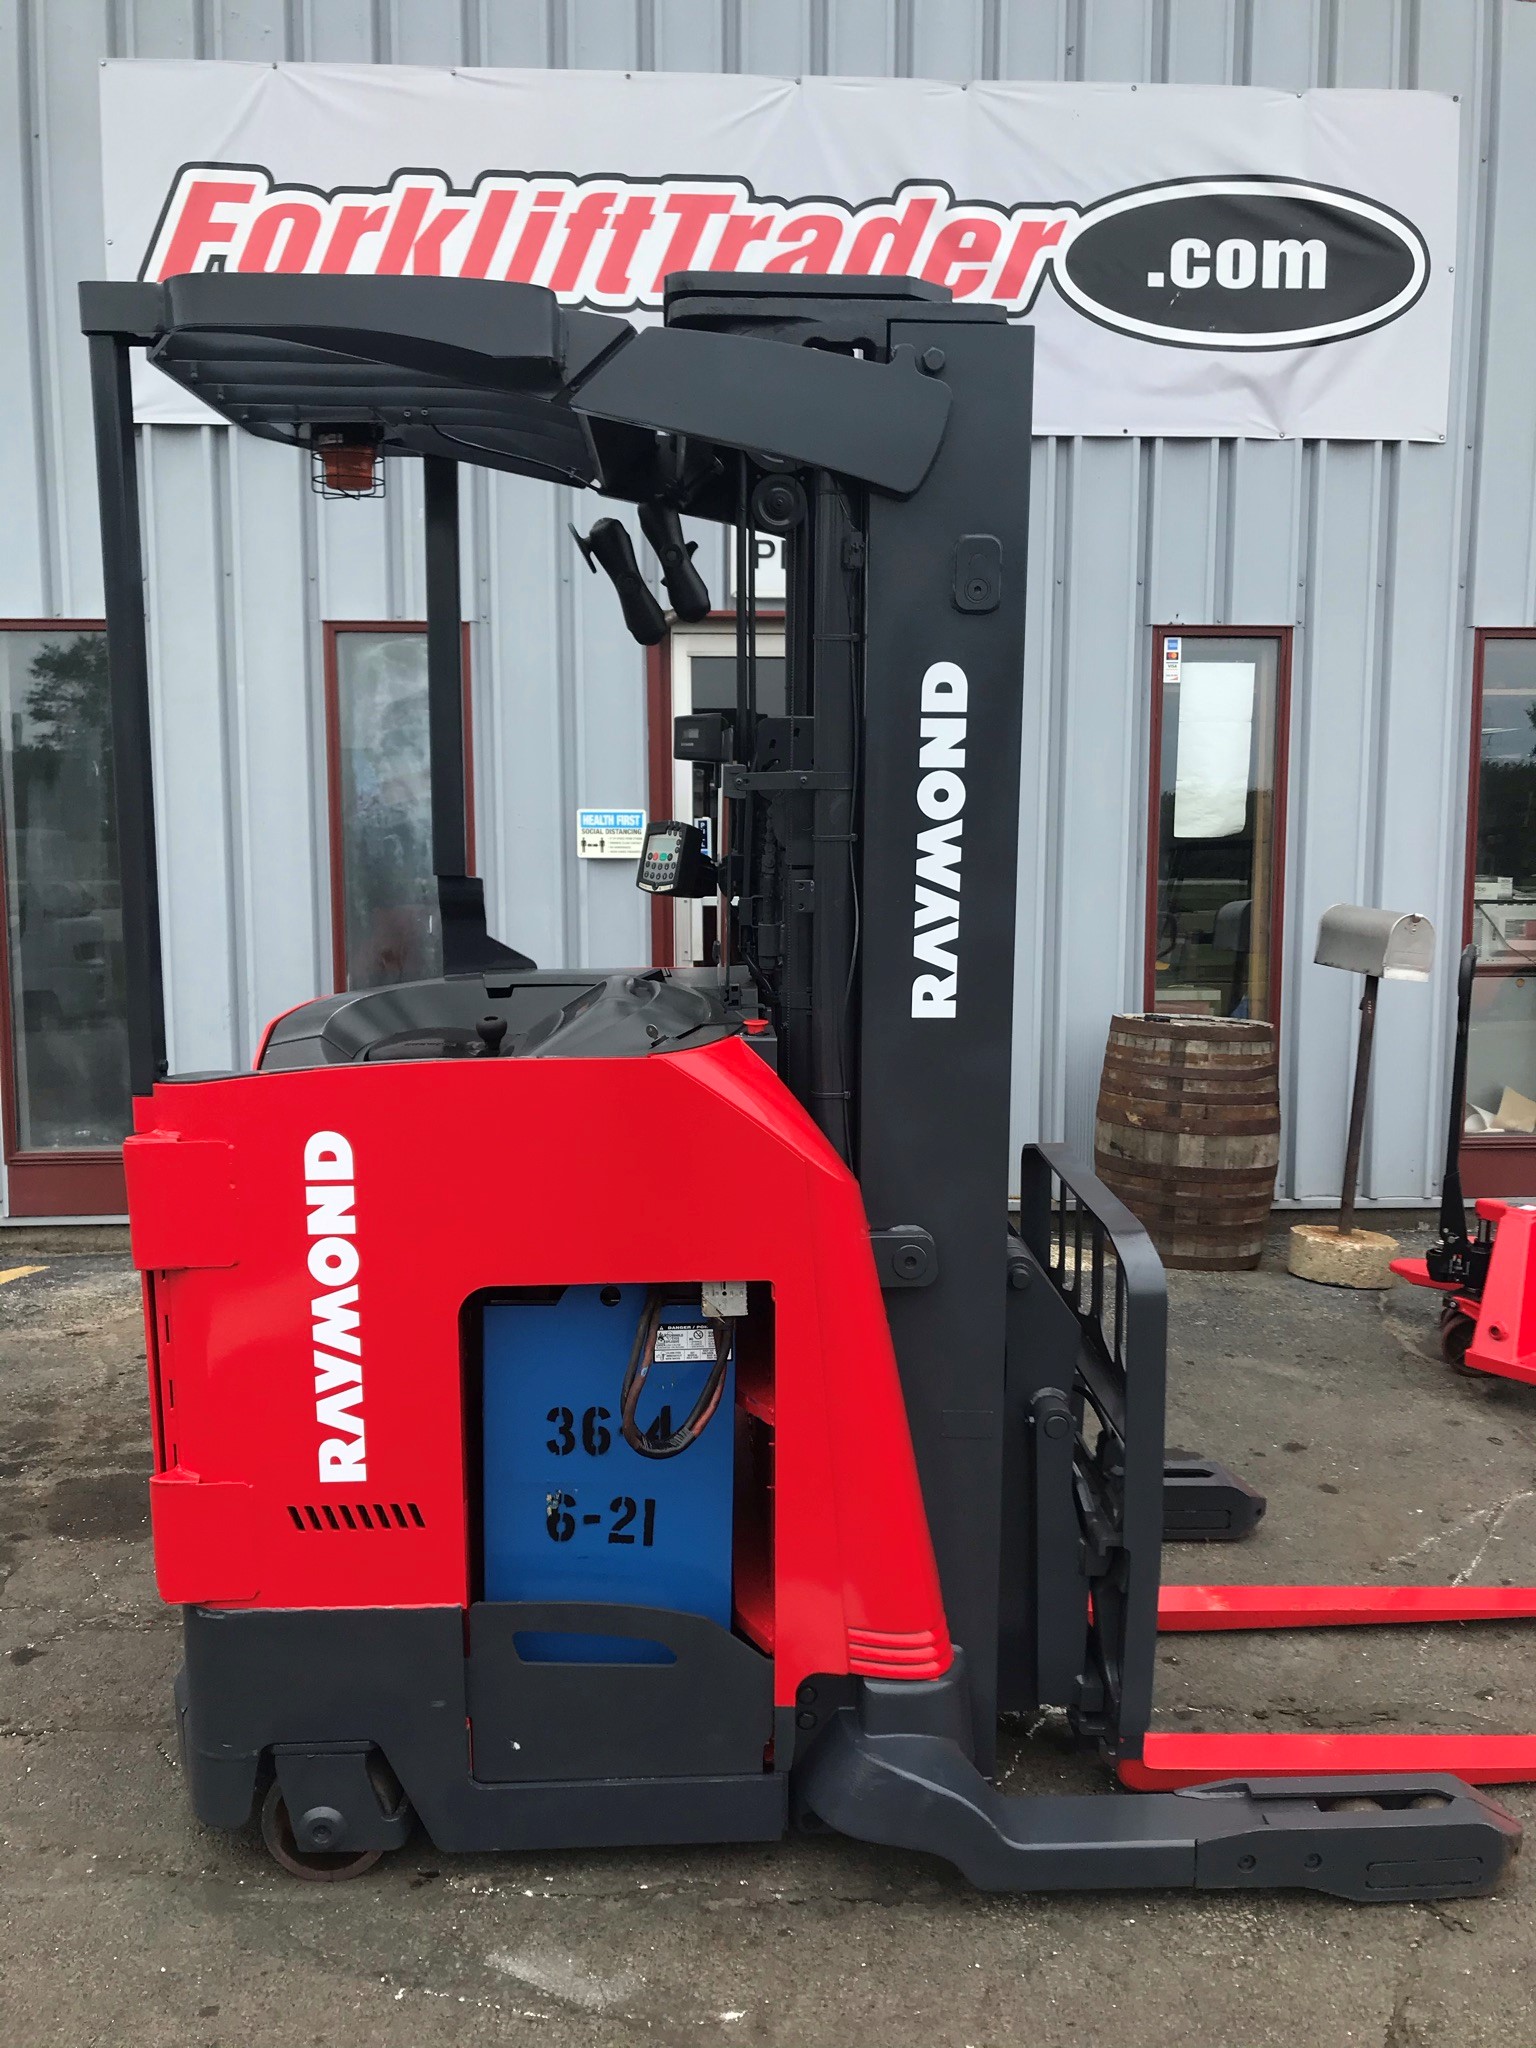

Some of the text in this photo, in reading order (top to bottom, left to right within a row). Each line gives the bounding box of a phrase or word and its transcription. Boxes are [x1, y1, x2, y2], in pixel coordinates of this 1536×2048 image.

[1147, 238, 1327, 289] .com
[582, 814, 640, 826] HEALTH FIRST
[912, 662, 968, 1019] RAYMOND
[304, 1131, 367, 1483] RAYMOND
